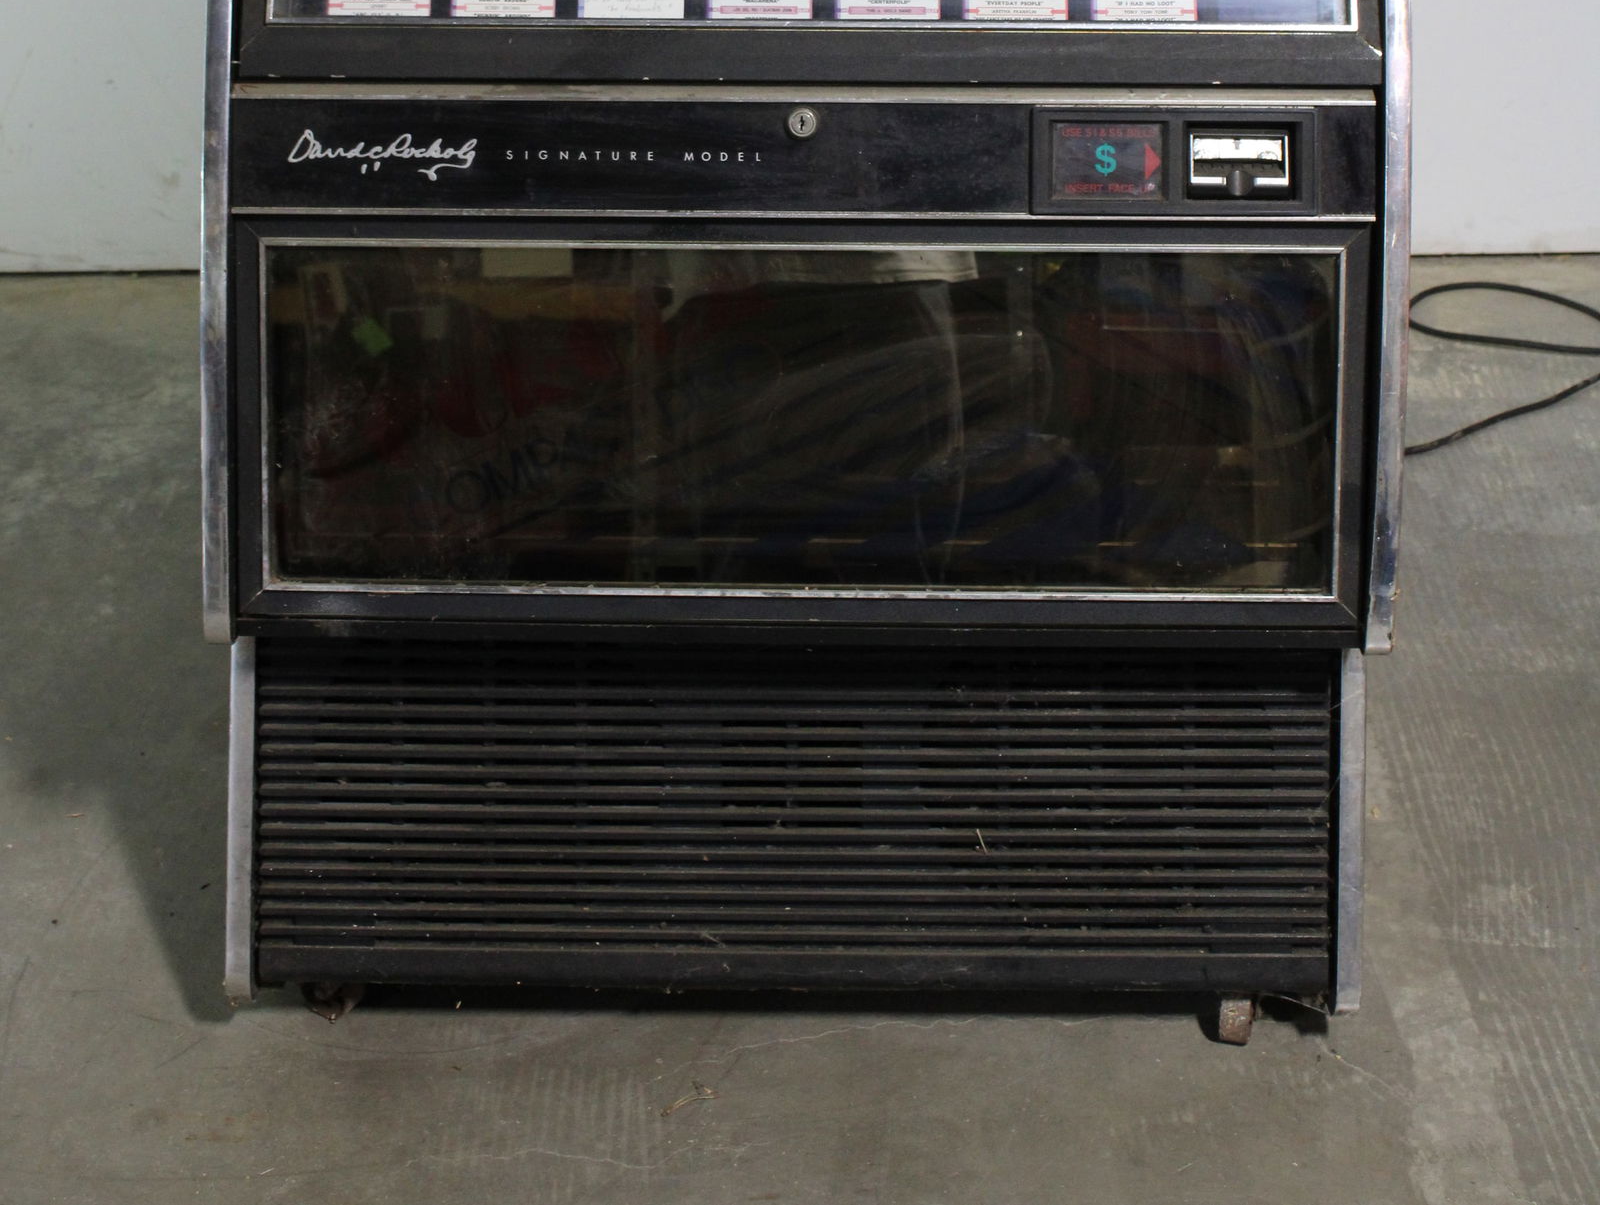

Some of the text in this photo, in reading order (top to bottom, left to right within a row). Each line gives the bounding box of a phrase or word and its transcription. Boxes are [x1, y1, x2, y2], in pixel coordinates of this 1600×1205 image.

[506, 150, 761, 162] SIGNATURE MODEL
[1095, 143, 1117, 176] $
